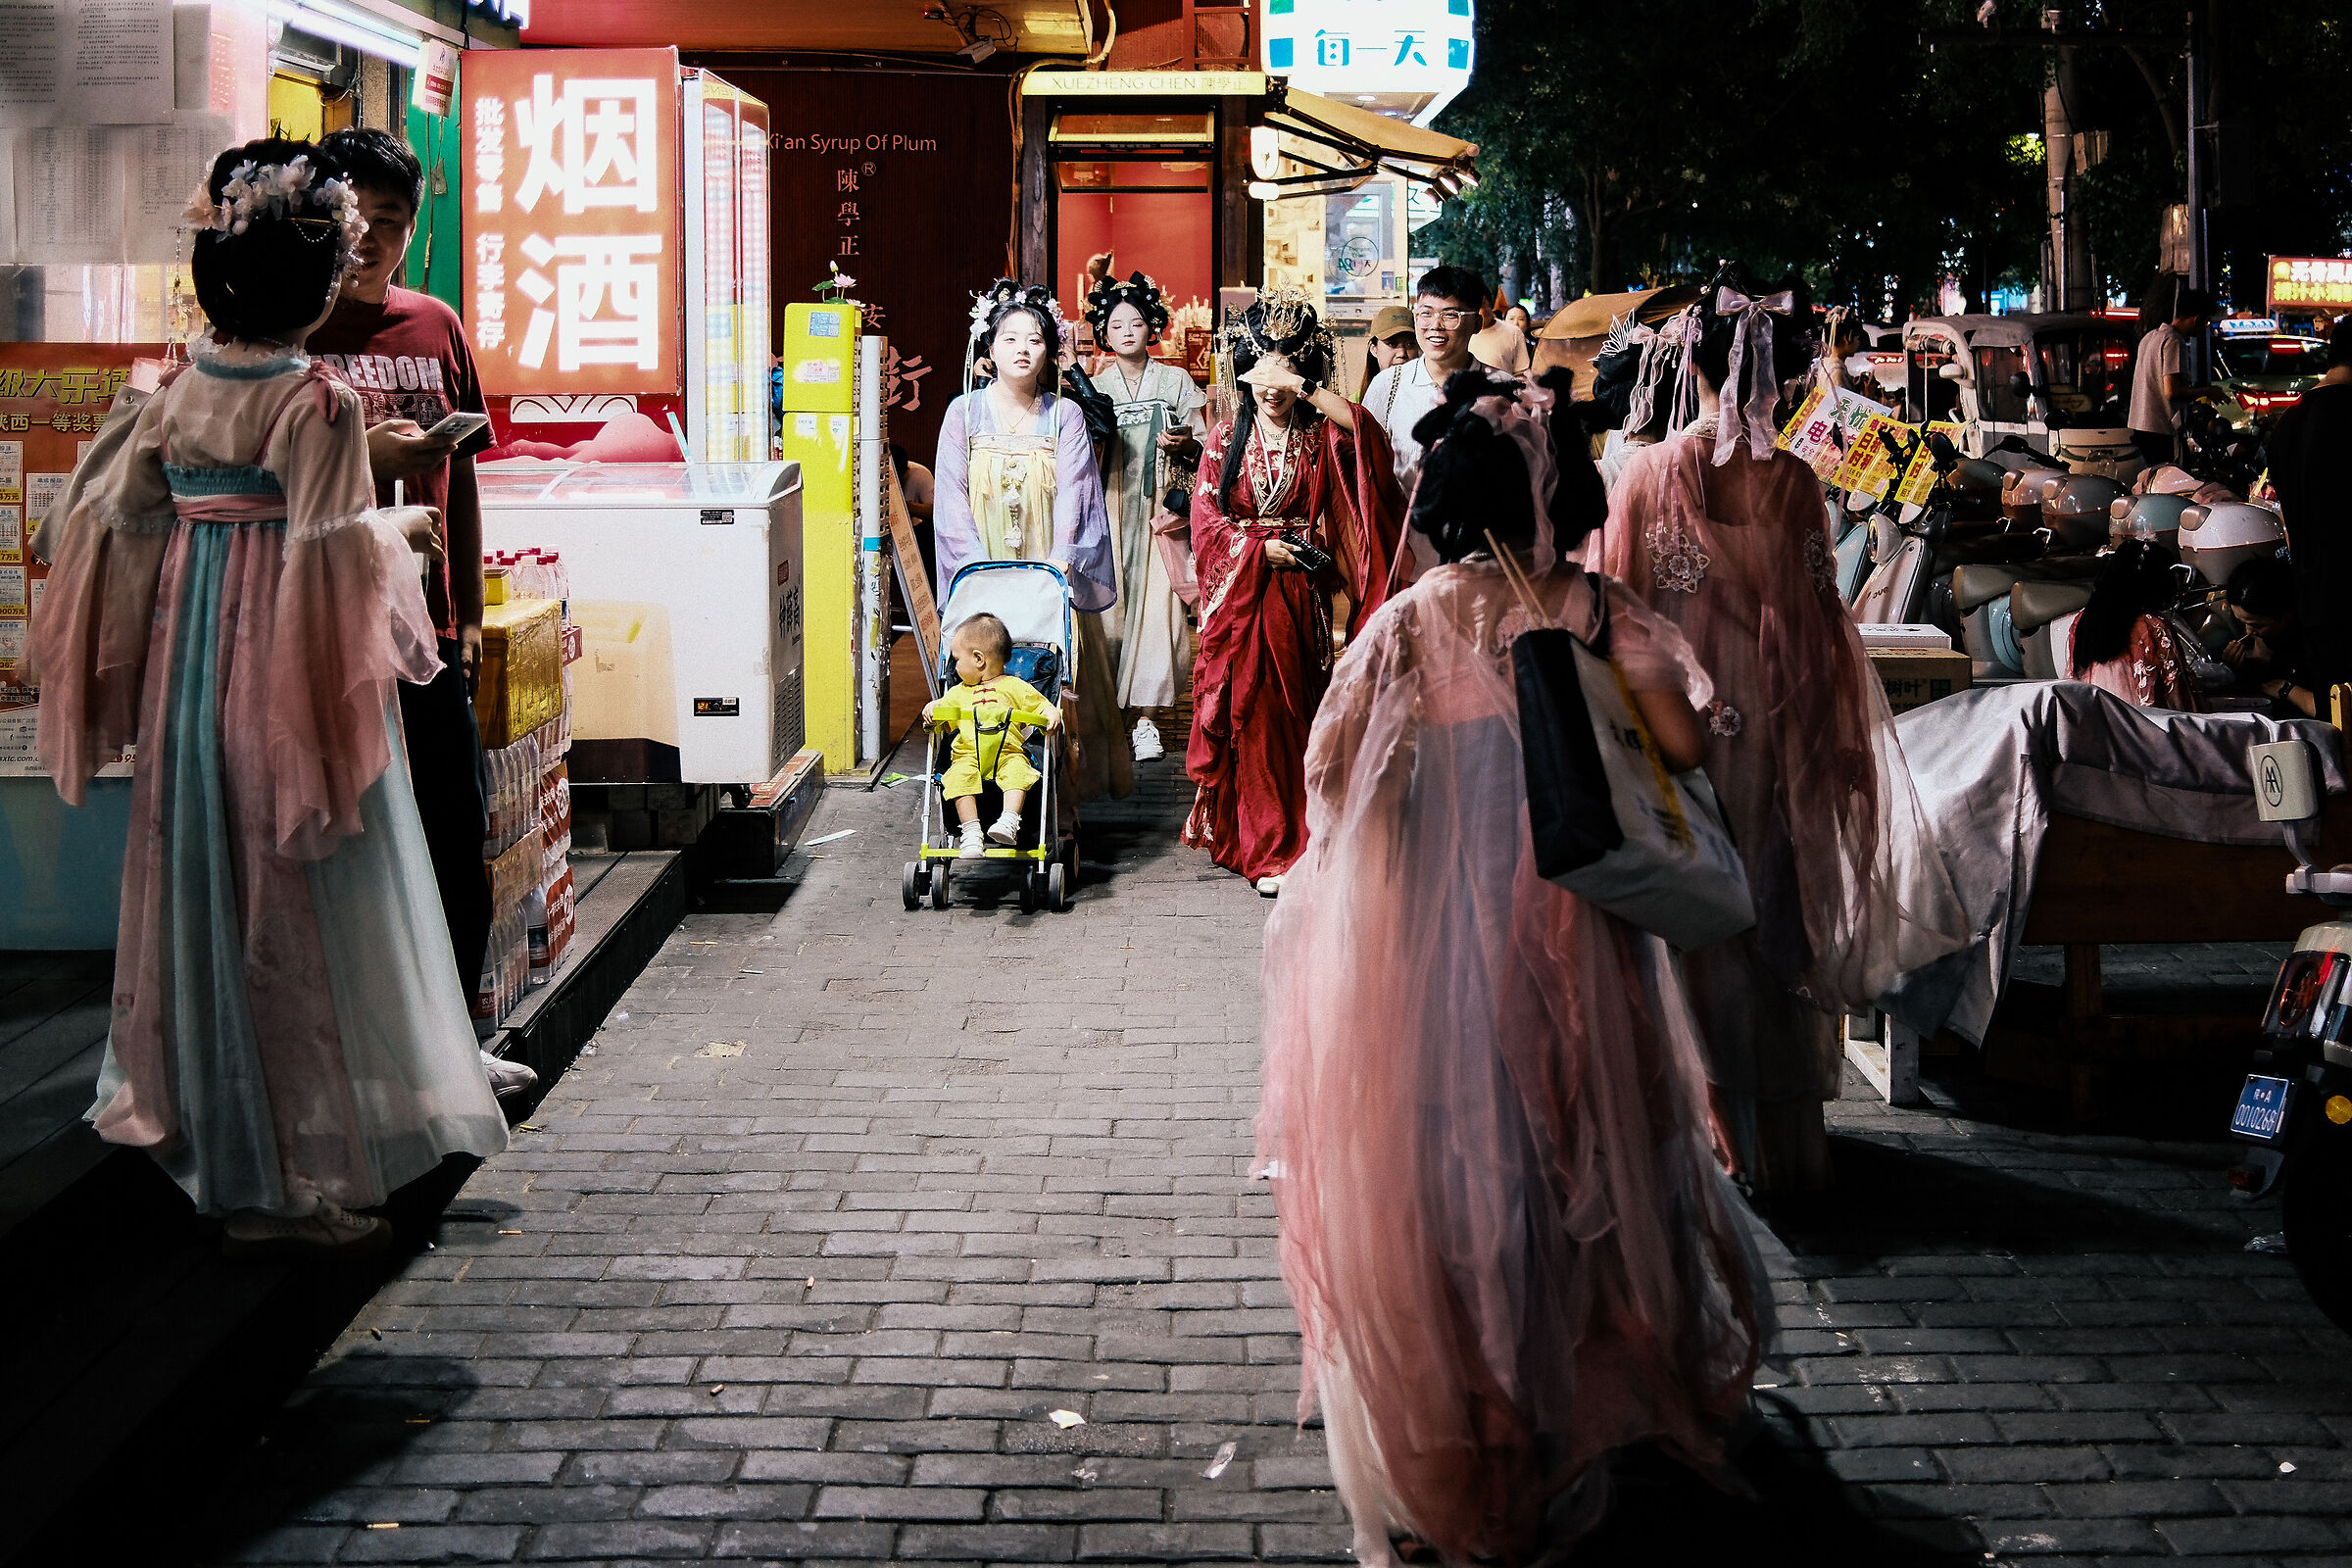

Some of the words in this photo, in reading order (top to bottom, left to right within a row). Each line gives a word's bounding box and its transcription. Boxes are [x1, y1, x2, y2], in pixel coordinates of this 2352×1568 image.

[1315, 29, 1427, 66] 每一天
[1052, 77, 1145, 90] XUEZHENG
[1150, 77, 1196, 90] CHEN
[475, 97, 505, 213] 批发零售
[810, 133, 860, 154] Syrup
[865, 133, 888, 150] Of
[893, 134, 937, 151] Plum
[514, 74, 662, 371] 烟酒
[837, 168, 860, 256] 陳學正
[476, 233, 506, 349] 行李寄存
[310, 354, 444, 391] REEDOM
